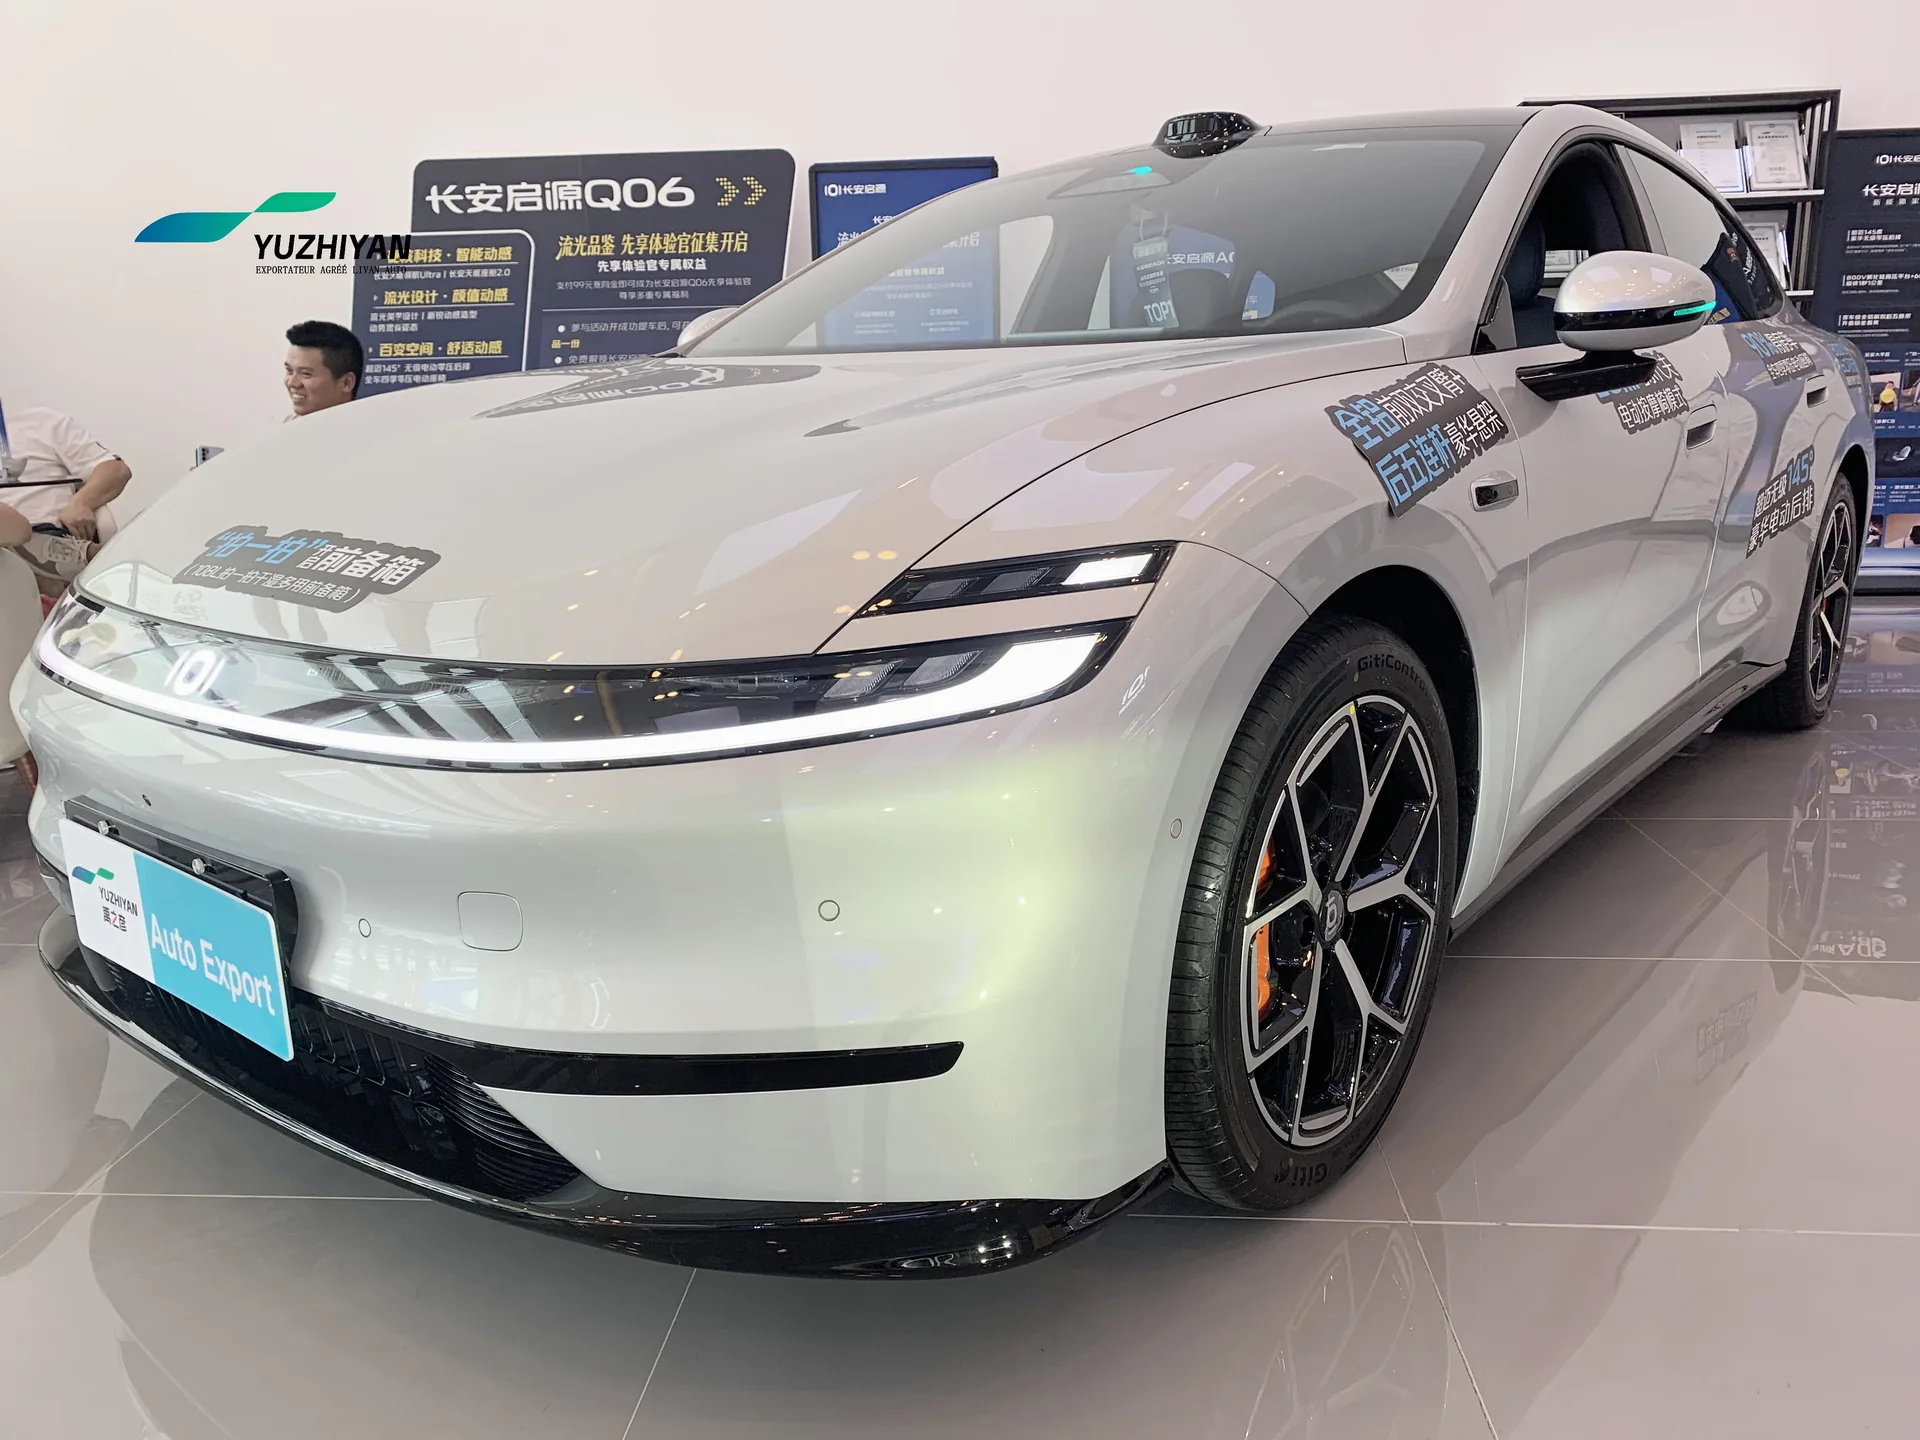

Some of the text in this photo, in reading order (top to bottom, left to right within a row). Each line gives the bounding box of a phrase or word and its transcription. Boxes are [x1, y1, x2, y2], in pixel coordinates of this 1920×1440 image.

[425, 177, 695, 214] 长安启源Q06
[843, 183, 887, 194] 长安启源
[555, 231, 749, 261] 流光品鉴 先享体验官征集开启
[597, 258, 707, 273] 先享体验官专属权益
[1144, 299, 1176, 324] TOP1
[551, 338, 581, 349] 品一份
[1375, 400, 1505, 508] 后五连杆豪华悬架
[1747, 484, 1814, 553] 豪华电动后排
[98, 885, 138, 917] YUZHIYAN
[151, 913, 276, 1016] Auto Export
